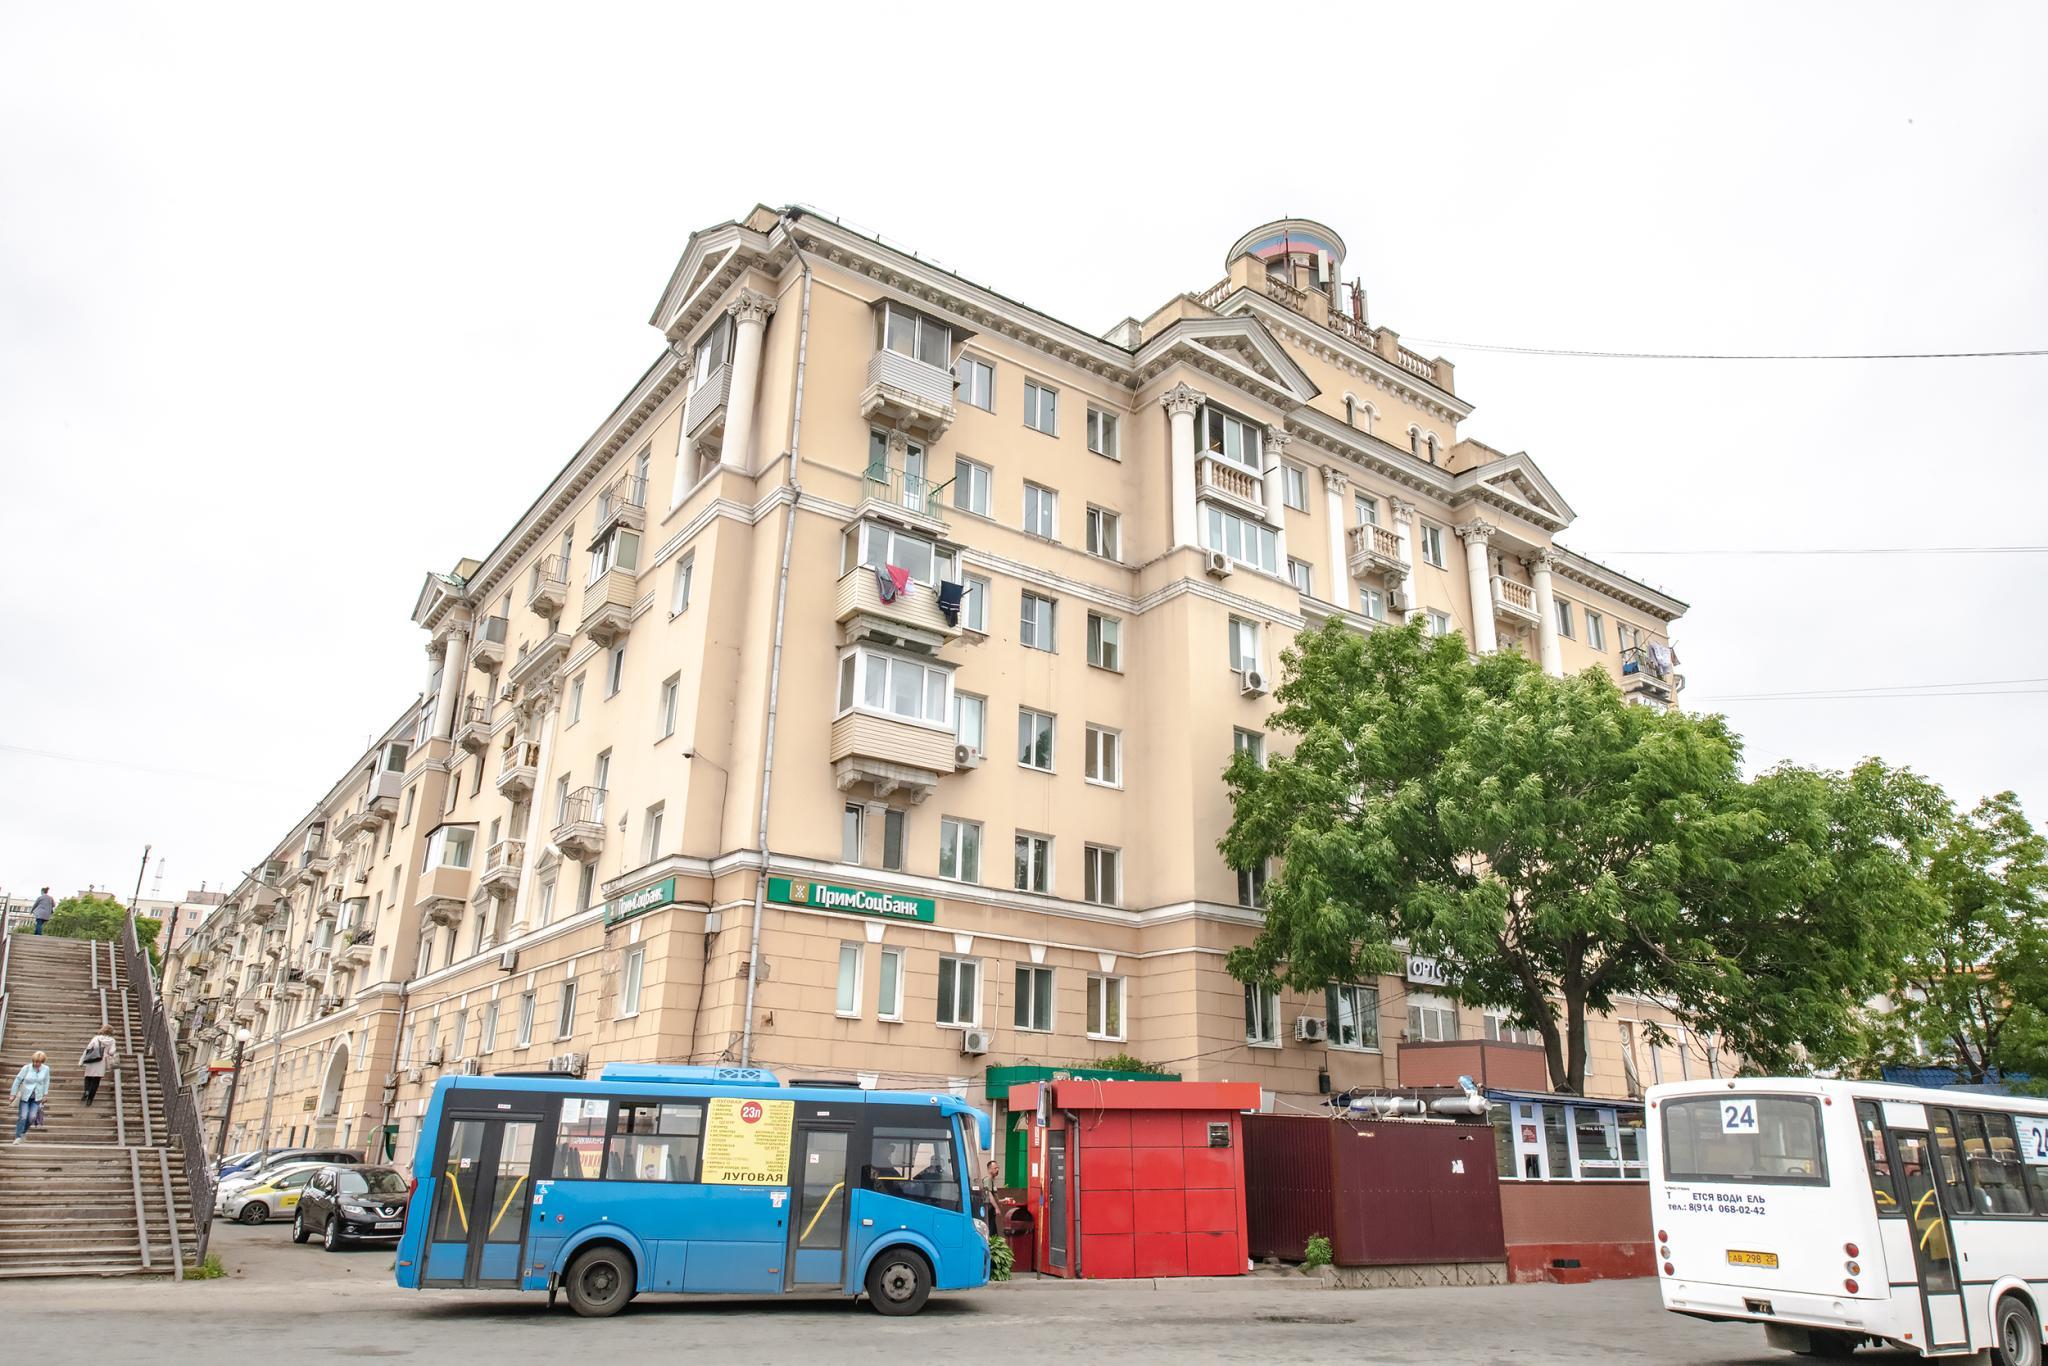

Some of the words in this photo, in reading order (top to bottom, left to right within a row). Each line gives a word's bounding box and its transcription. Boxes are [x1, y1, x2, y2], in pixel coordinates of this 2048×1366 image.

[816, 885, 918, 916] ПримСоцБанк
[743, 1106, 761, 1118] 23л
[1725, 1105, 1755, 1128] 24
[2032, 1127, 2048, 1157] 2
[722, 1172, 783, 1182] ЛУГОВАЯ
[1746, 1254, 1761, 1264] 298
